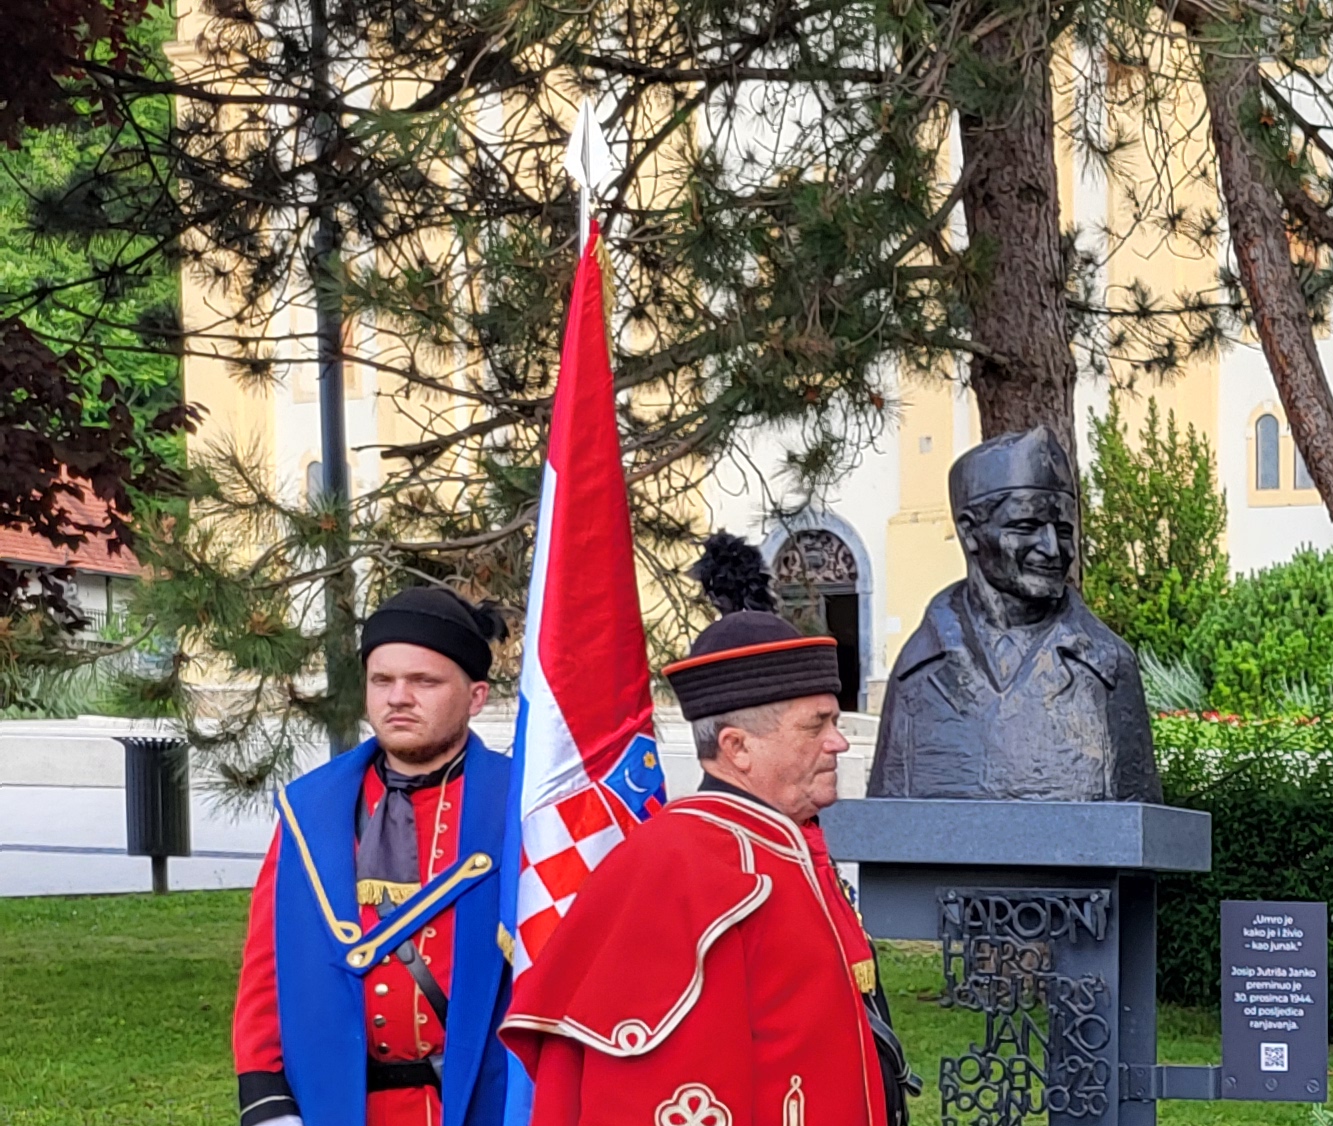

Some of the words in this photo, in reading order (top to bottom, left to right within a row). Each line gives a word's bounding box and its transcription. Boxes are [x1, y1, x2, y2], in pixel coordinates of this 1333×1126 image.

[939, 896, 1108, 942] NARODNI
[1283, 915, 1293, 926] je
[1243, 928, 1265, 937] kako
[1266, 928, 1275, 939] je
[1252, 941, 1269, 950] kao
[1231, 967, 1255, 977] Josip
[1289, 967, 1316, 977] Janko
[1246, 980, 1291, 990] preminuo
[1292, 981, 1302, 992] je
[1234, 993, 1248, 1002] 30.
[1249, 994, 1288, 1003] prosinca
[1290, 994, 1314, 1003] 1944.
[1244, 1007, 1256, 1015] od
[1258, 1007, 1304, 1017] posljedica
[1250, 1020, 1299, 1031] ranjavanja.
